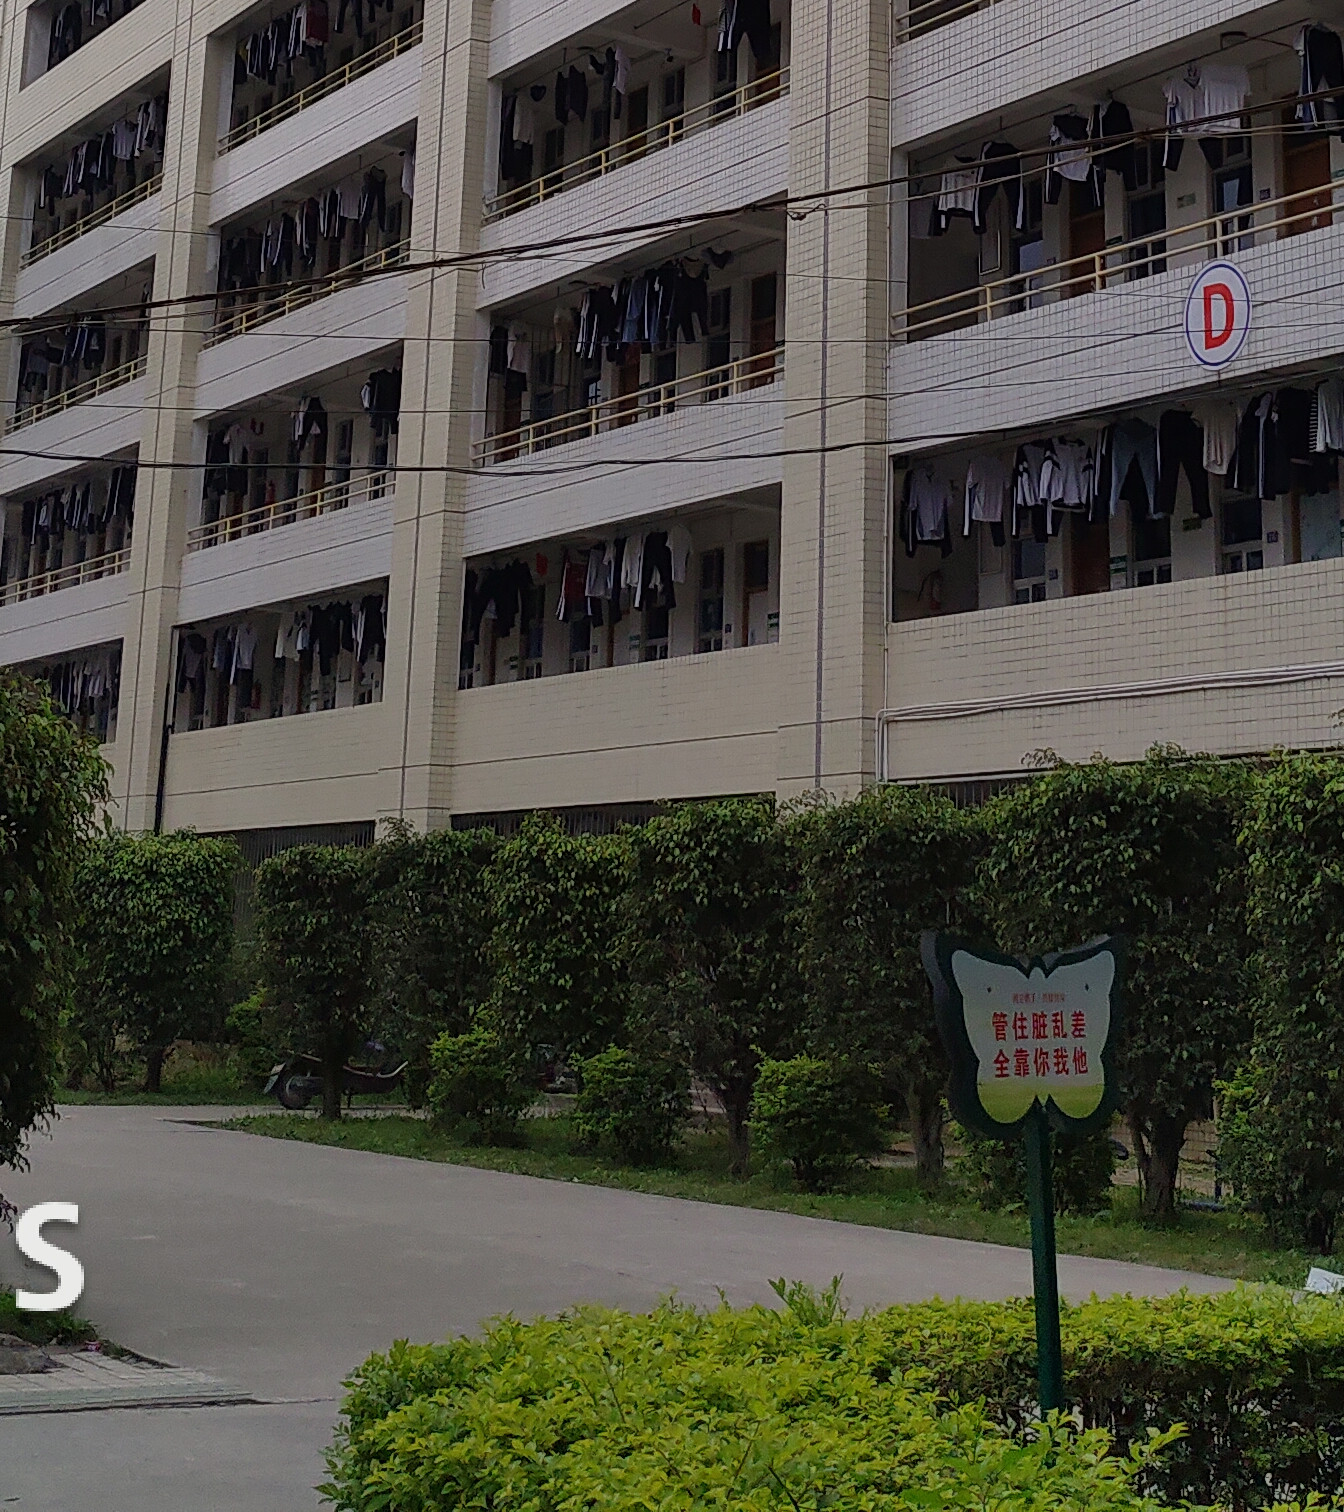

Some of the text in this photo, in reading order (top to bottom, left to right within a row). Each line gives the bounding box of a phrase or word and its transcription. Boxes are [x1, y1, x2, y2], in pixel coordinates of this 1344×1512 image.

[1203, 283, 1234, 350] D
[992, 1010, 1086, 1042] 管住脏乱差
[994, 1046, 1088, 1078] 全靠你我他
